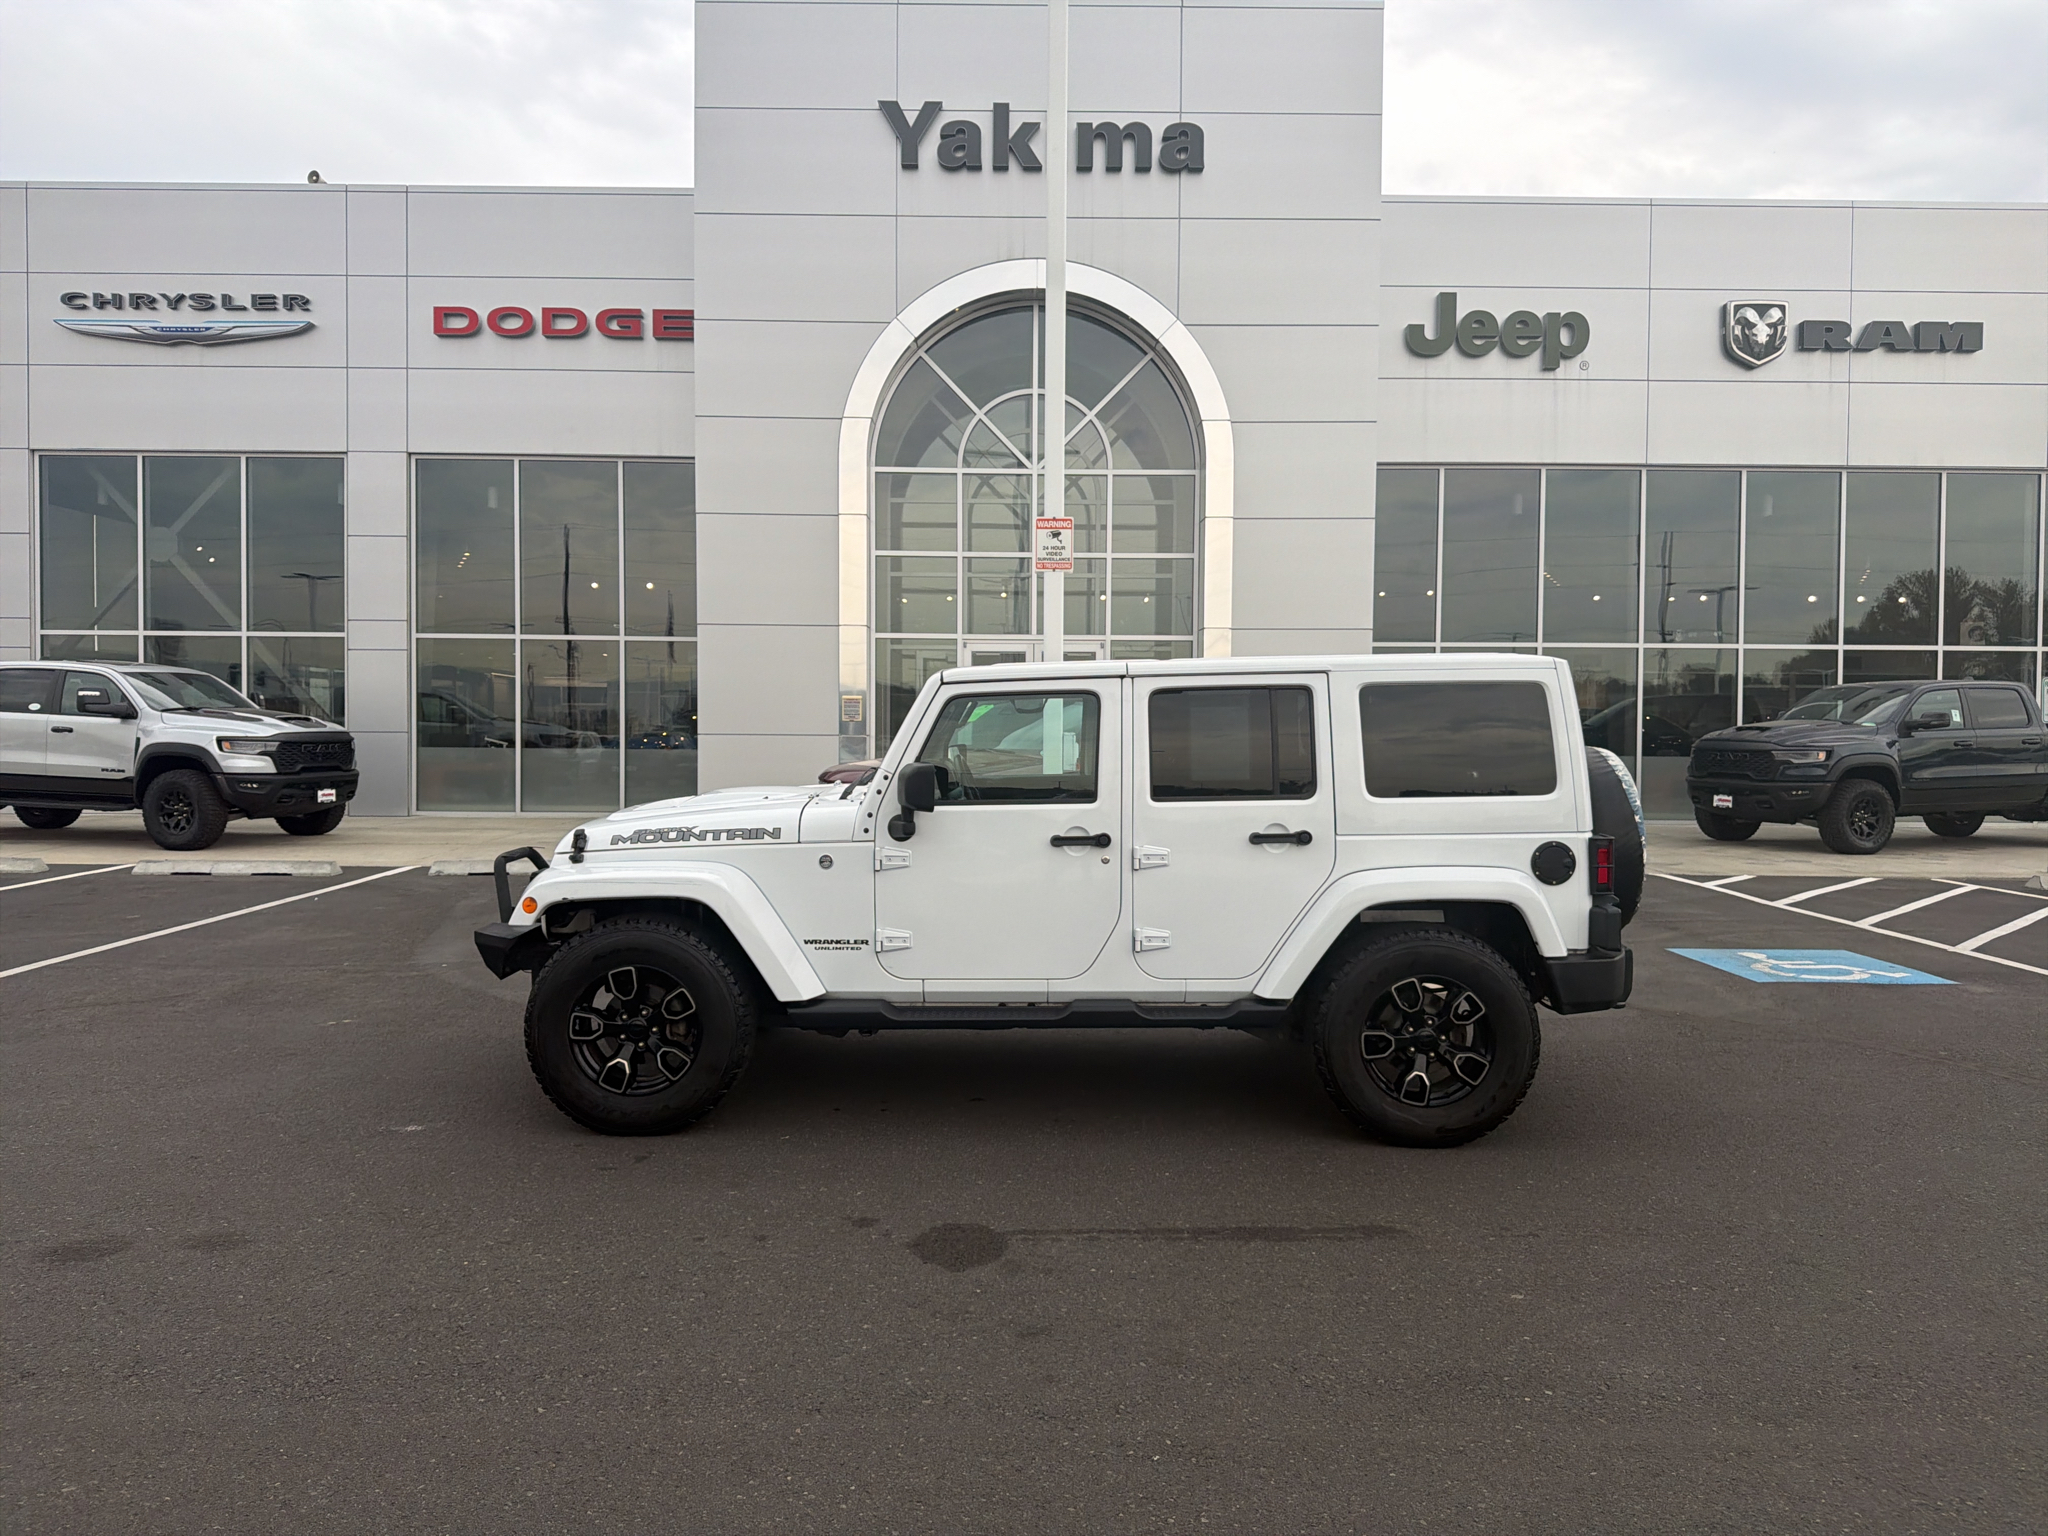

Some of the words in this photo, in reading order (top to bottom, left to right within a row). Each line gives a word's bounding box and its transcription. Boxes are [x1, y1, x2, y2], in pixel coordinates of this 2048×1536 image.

[877, 100, 1205, 172] Yakma
[59, 291, 312, 311] CHRYSLER
[433, 305, 695, 340] DODGE
[1404, 291, 1591, 371] Jeep
[1798, 319, 1985, 352] RAM
[1036, 520, 1072, 528] WARNING
[610, 827, 782, 846] MOUNTAIN
